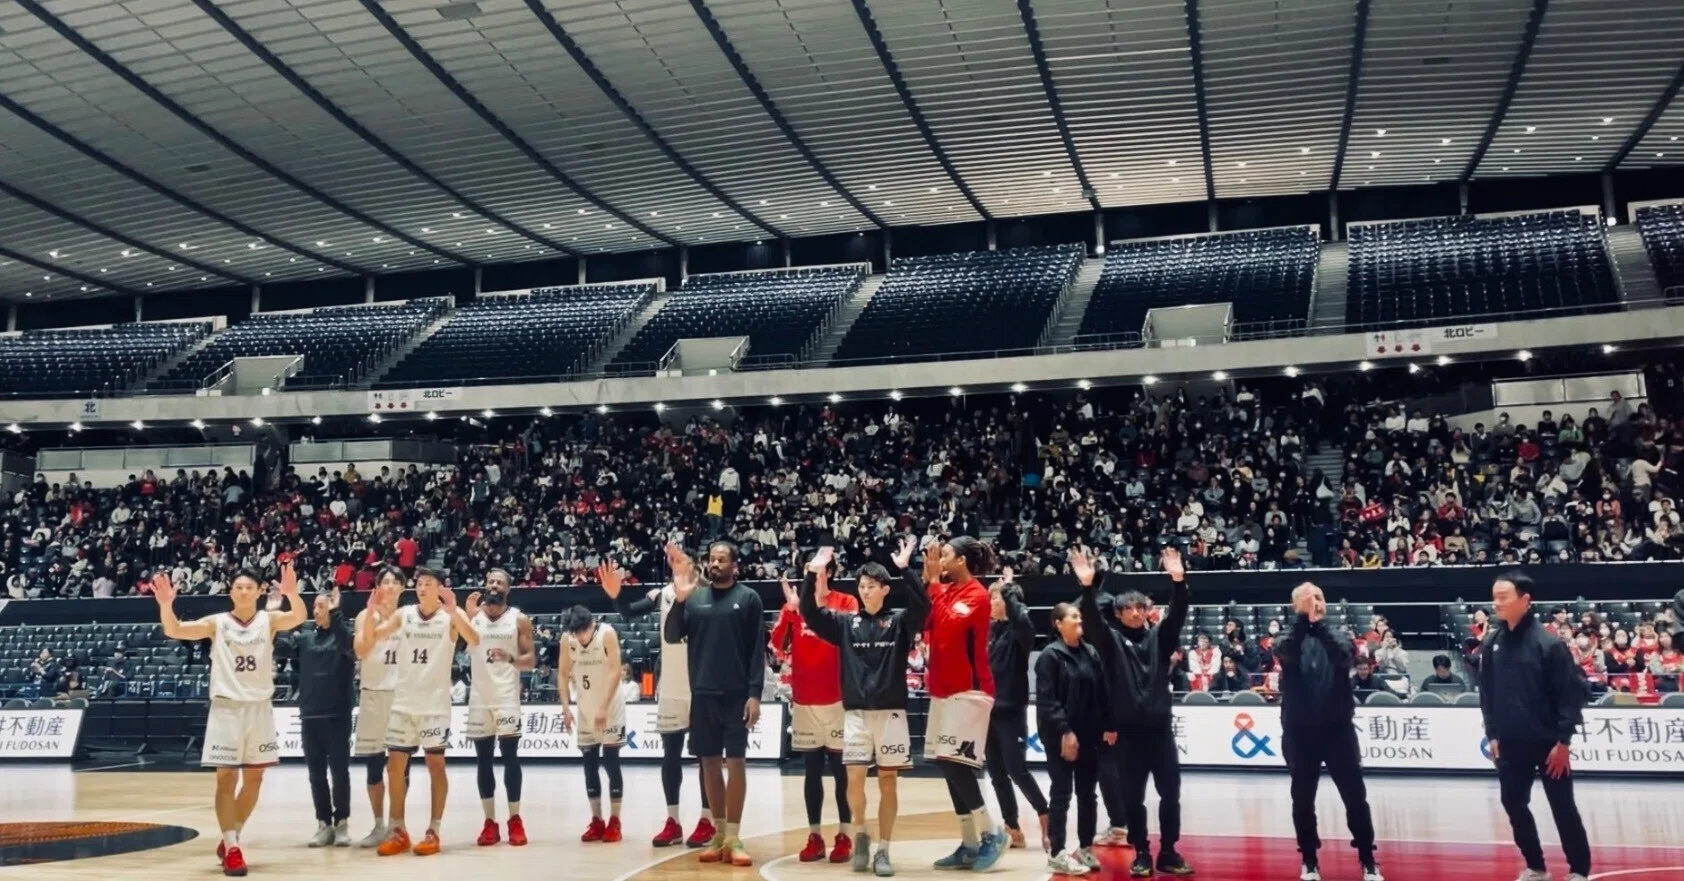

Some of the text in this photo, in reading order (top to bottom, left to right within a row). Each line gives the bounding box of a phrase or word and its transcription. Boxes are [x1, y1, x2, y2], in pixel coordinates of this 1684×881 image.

[1443, 326, 1484, 339] 北ロビー
[84, 401, 97, 414] 北
[384, 649, 398, 665] 11
[411, 648, 428, 665] 14
[234, 655, 257, 672] 28
[582, 674, 591, 690] 5
[830, 729, 845, 739] OS
[6, 740, 60, 751] FUDOSAN
[519, 739, 569, 749] DOSAN
[880, 744, 906, 755] OSG
[1361, 746, 1433, 759] UDOSAN
[1570, 749, 1684, 763] SUI FUDOSA
